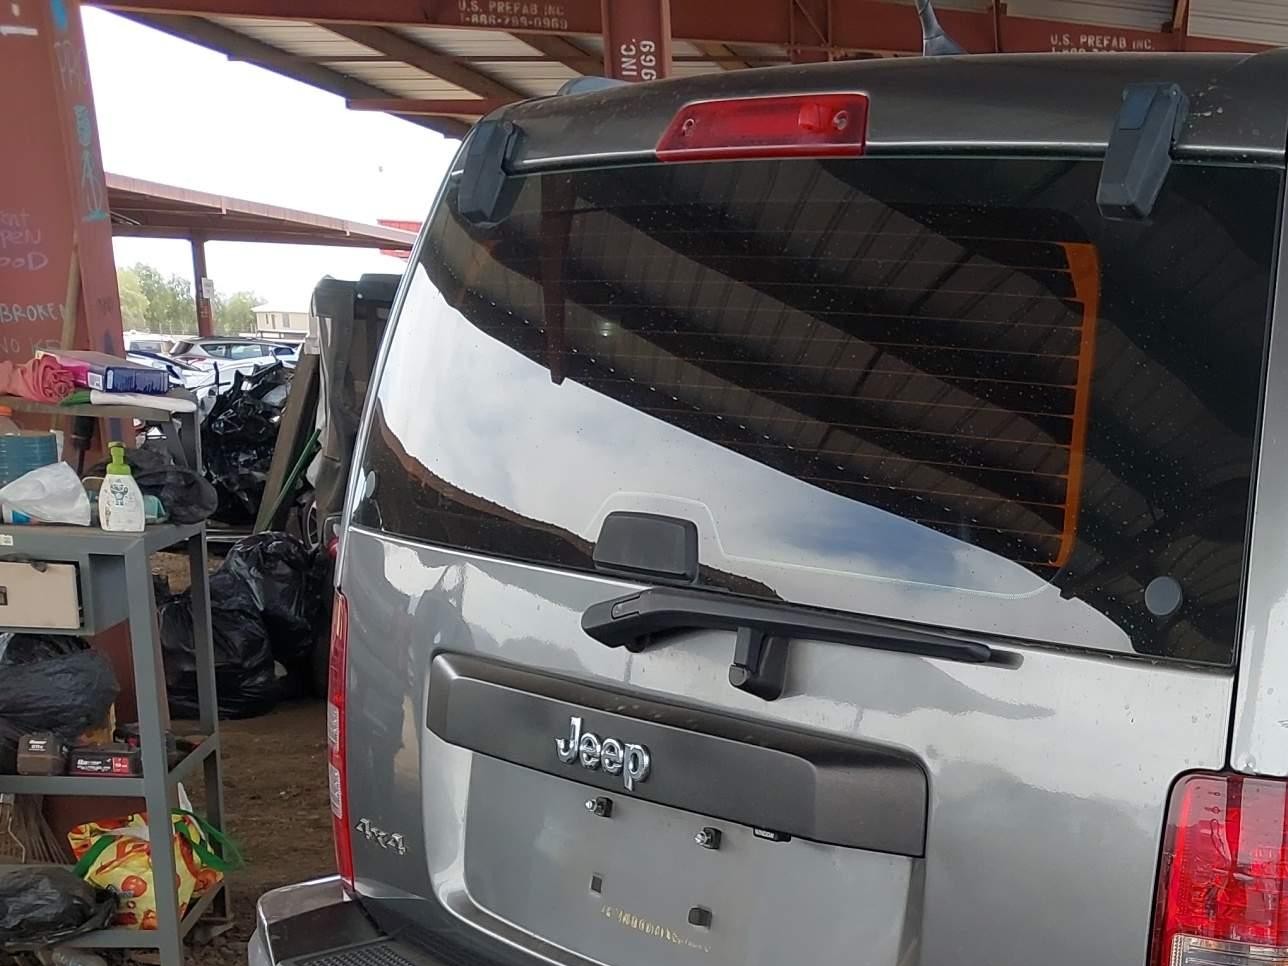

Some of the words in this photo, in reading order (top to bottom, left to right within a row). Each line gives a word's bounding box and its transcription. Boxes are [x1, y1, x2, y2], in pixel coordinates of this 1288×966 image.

[488, 1, 538, 16] PREFAB
[1080, 34, 1127, 48] PREFAB
[555, 716, 650, 792] Jeep
